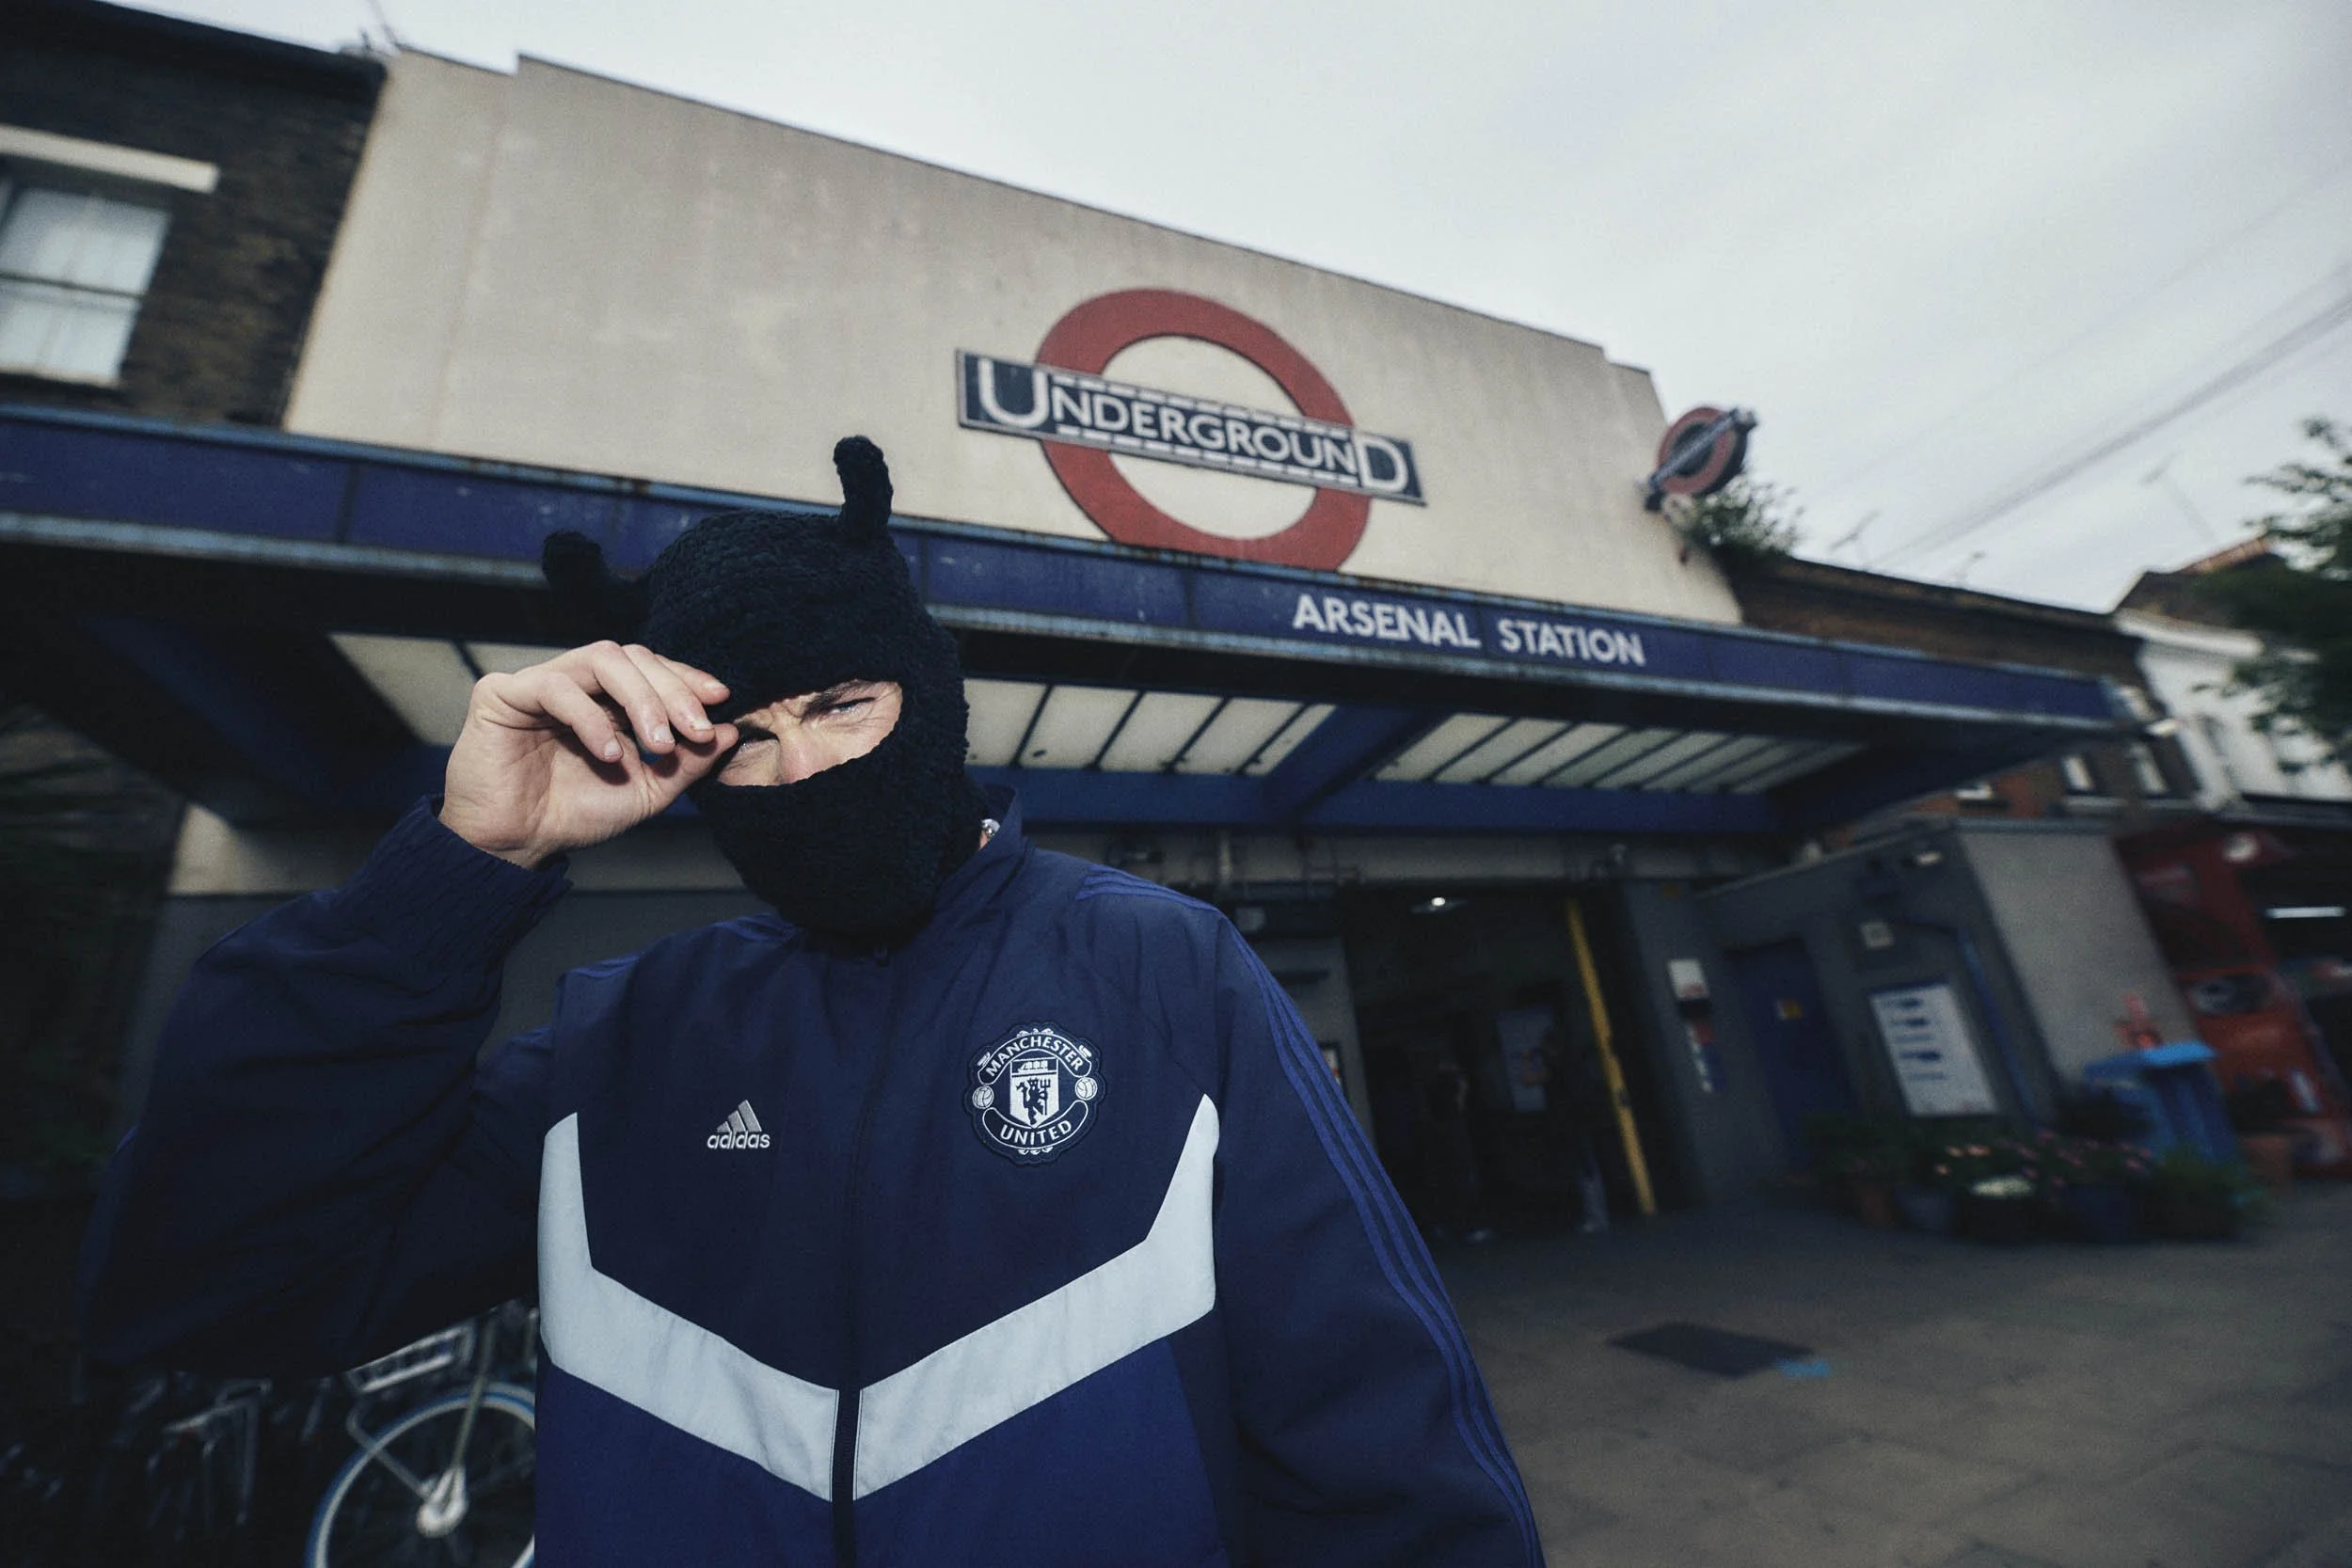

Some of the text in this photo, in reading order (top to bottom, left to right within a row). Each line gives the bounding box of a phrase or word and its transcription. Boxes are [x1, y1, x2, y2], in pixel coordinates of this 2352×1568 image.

[977, 357, 1409, 493] UNDERGROUND
[1293, 594, 1646, 666] ARSENAL STATION
[985, 1036, 1084, 1077] MANCHESTER
[707, 1131, 771, 1149] adidas
[1000, 1119, 1073, 1146] UNITED
